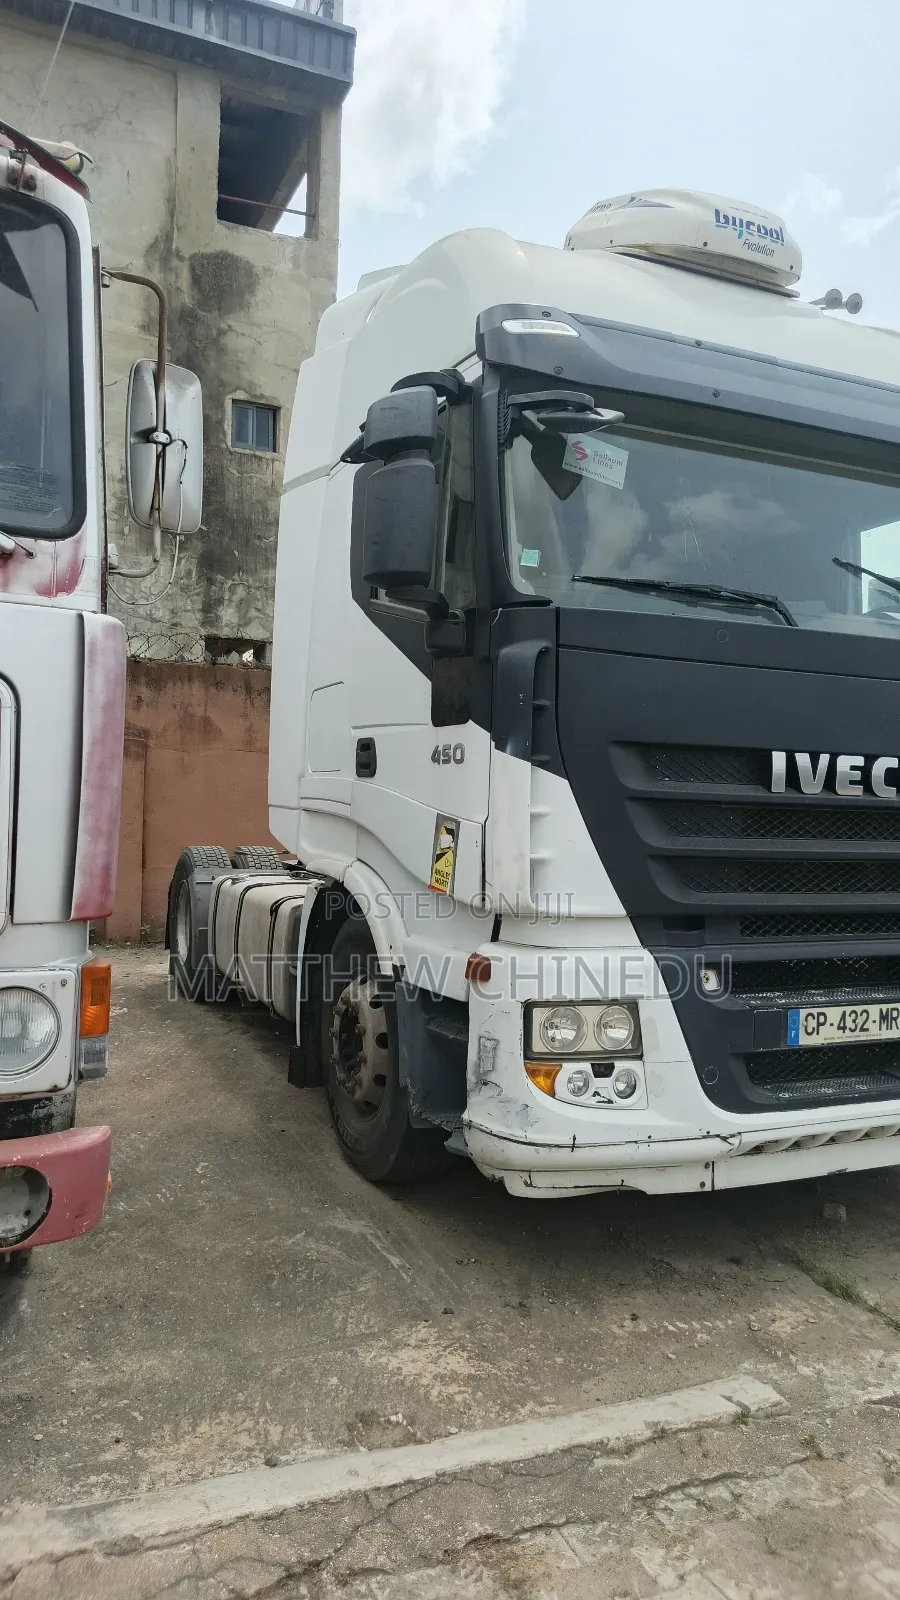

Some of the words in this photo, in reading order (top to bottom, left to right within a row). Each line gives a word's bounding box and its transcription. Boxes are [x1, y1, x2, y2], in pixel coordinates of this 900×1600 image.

[714, 208, 785, 247] bycool
[592, 456, 613, 470] Lines
[593, 450, 624, 467] Sallaum
[430, 743, 466, 766] 450
[803, 1006, 900, 1037] CP-432-MR
[790, 1030, 796, 1039] F
